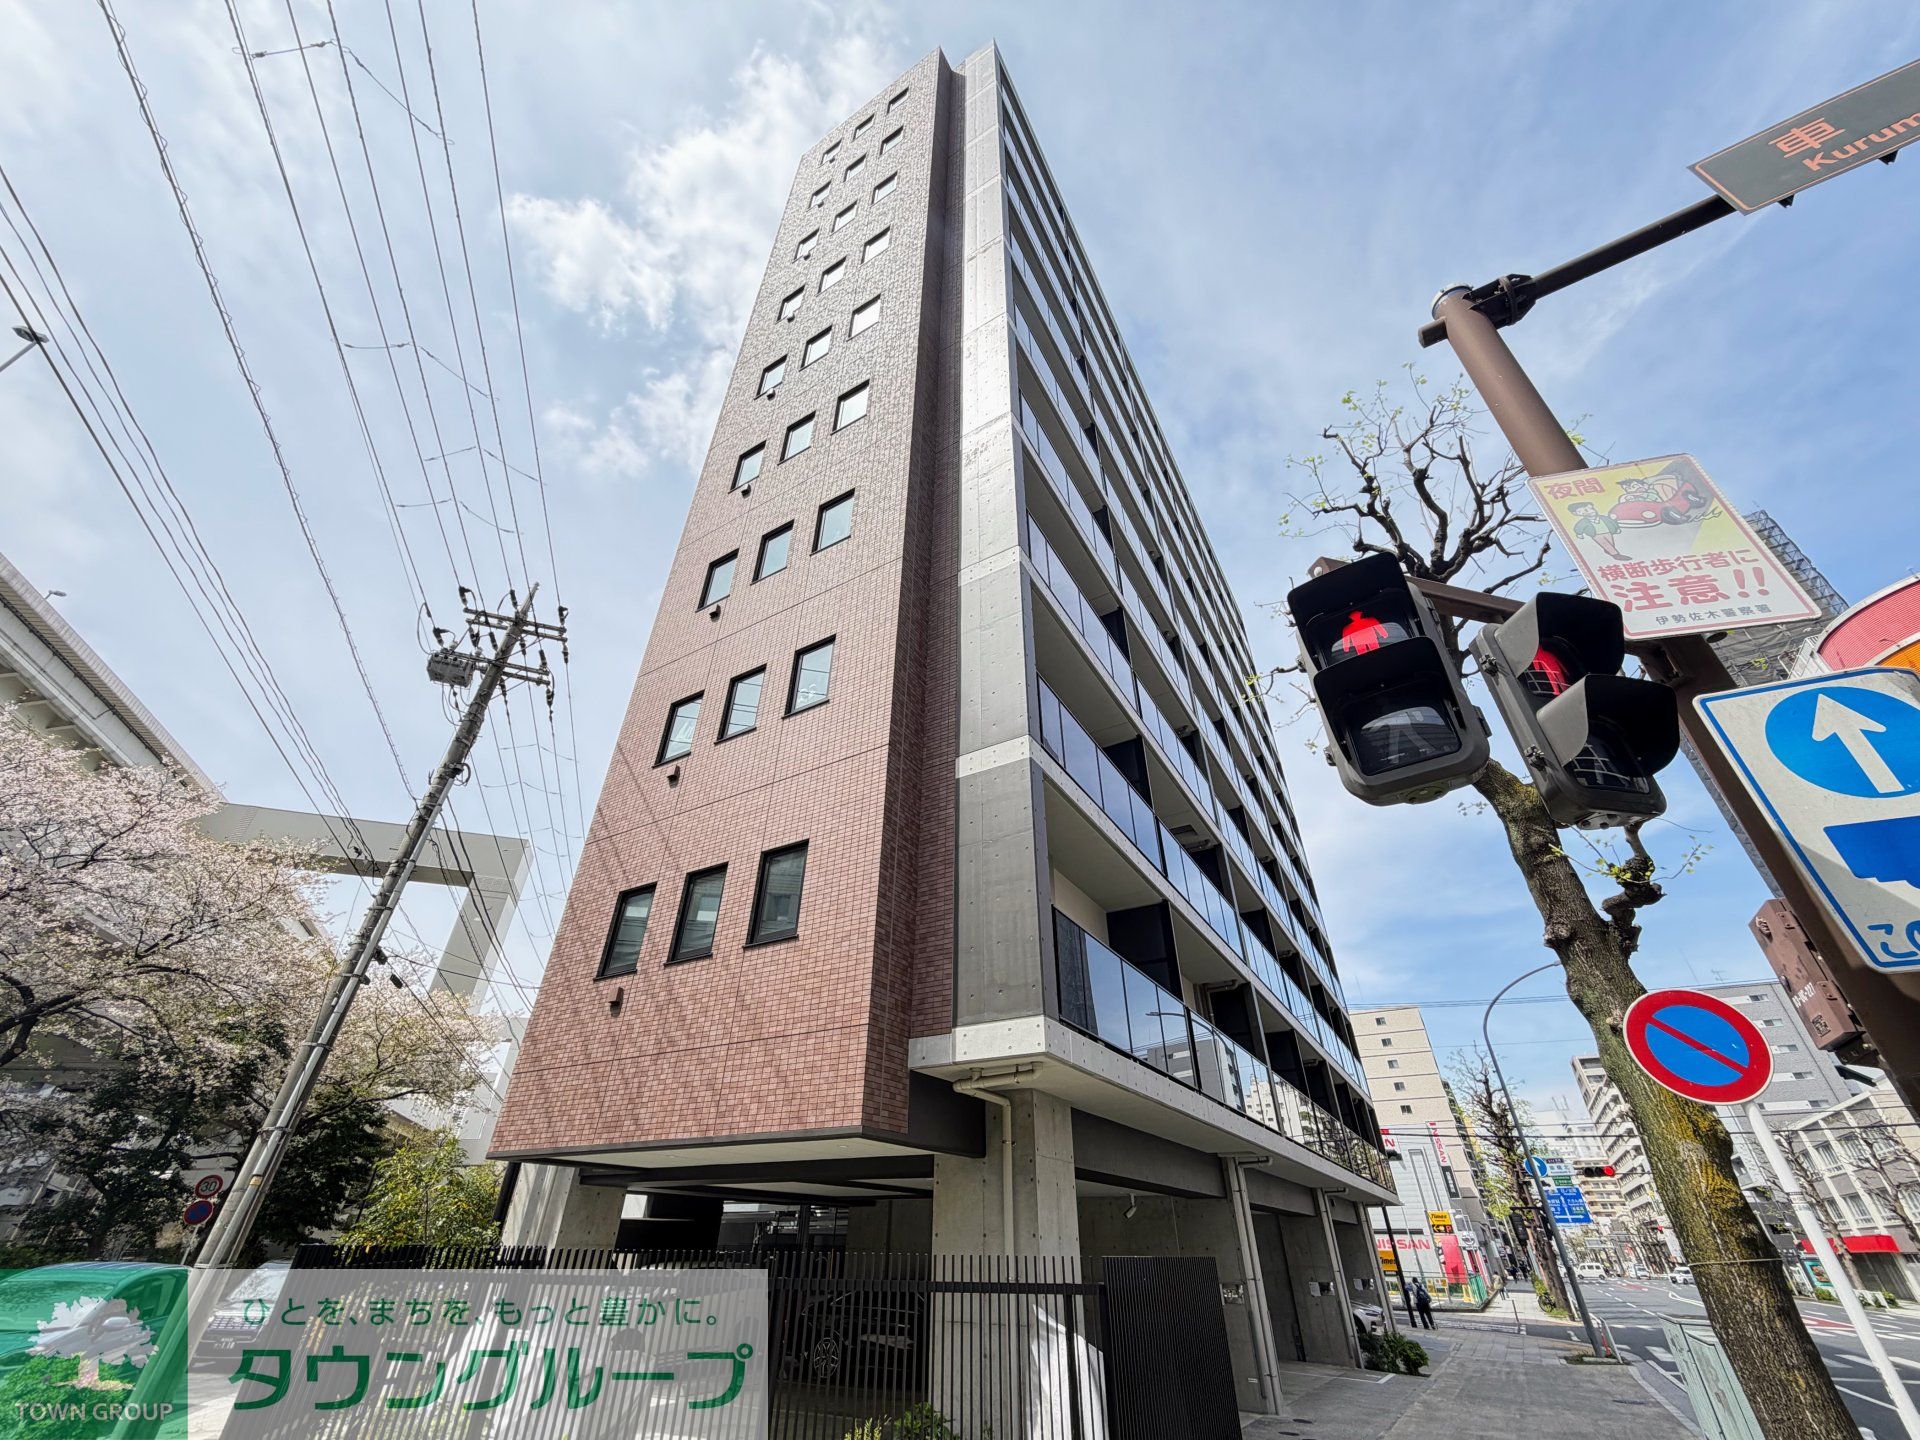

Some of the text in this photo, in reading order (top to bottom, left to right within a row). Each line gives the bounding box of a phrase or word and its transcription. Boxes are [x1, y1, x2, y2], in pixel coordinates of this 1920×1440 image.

[1768, 117, 1846, 158] 車
[1543, 477, 1605, 499] 夜間
[1598, 549, 1759, 582] 横断歩行者に
[1655, 603, 1772, 625] 伊勢佐木警察署
[200, 1181, 218, 1192] 30
[1376, 1238, 1431, 1249] NISSAN
